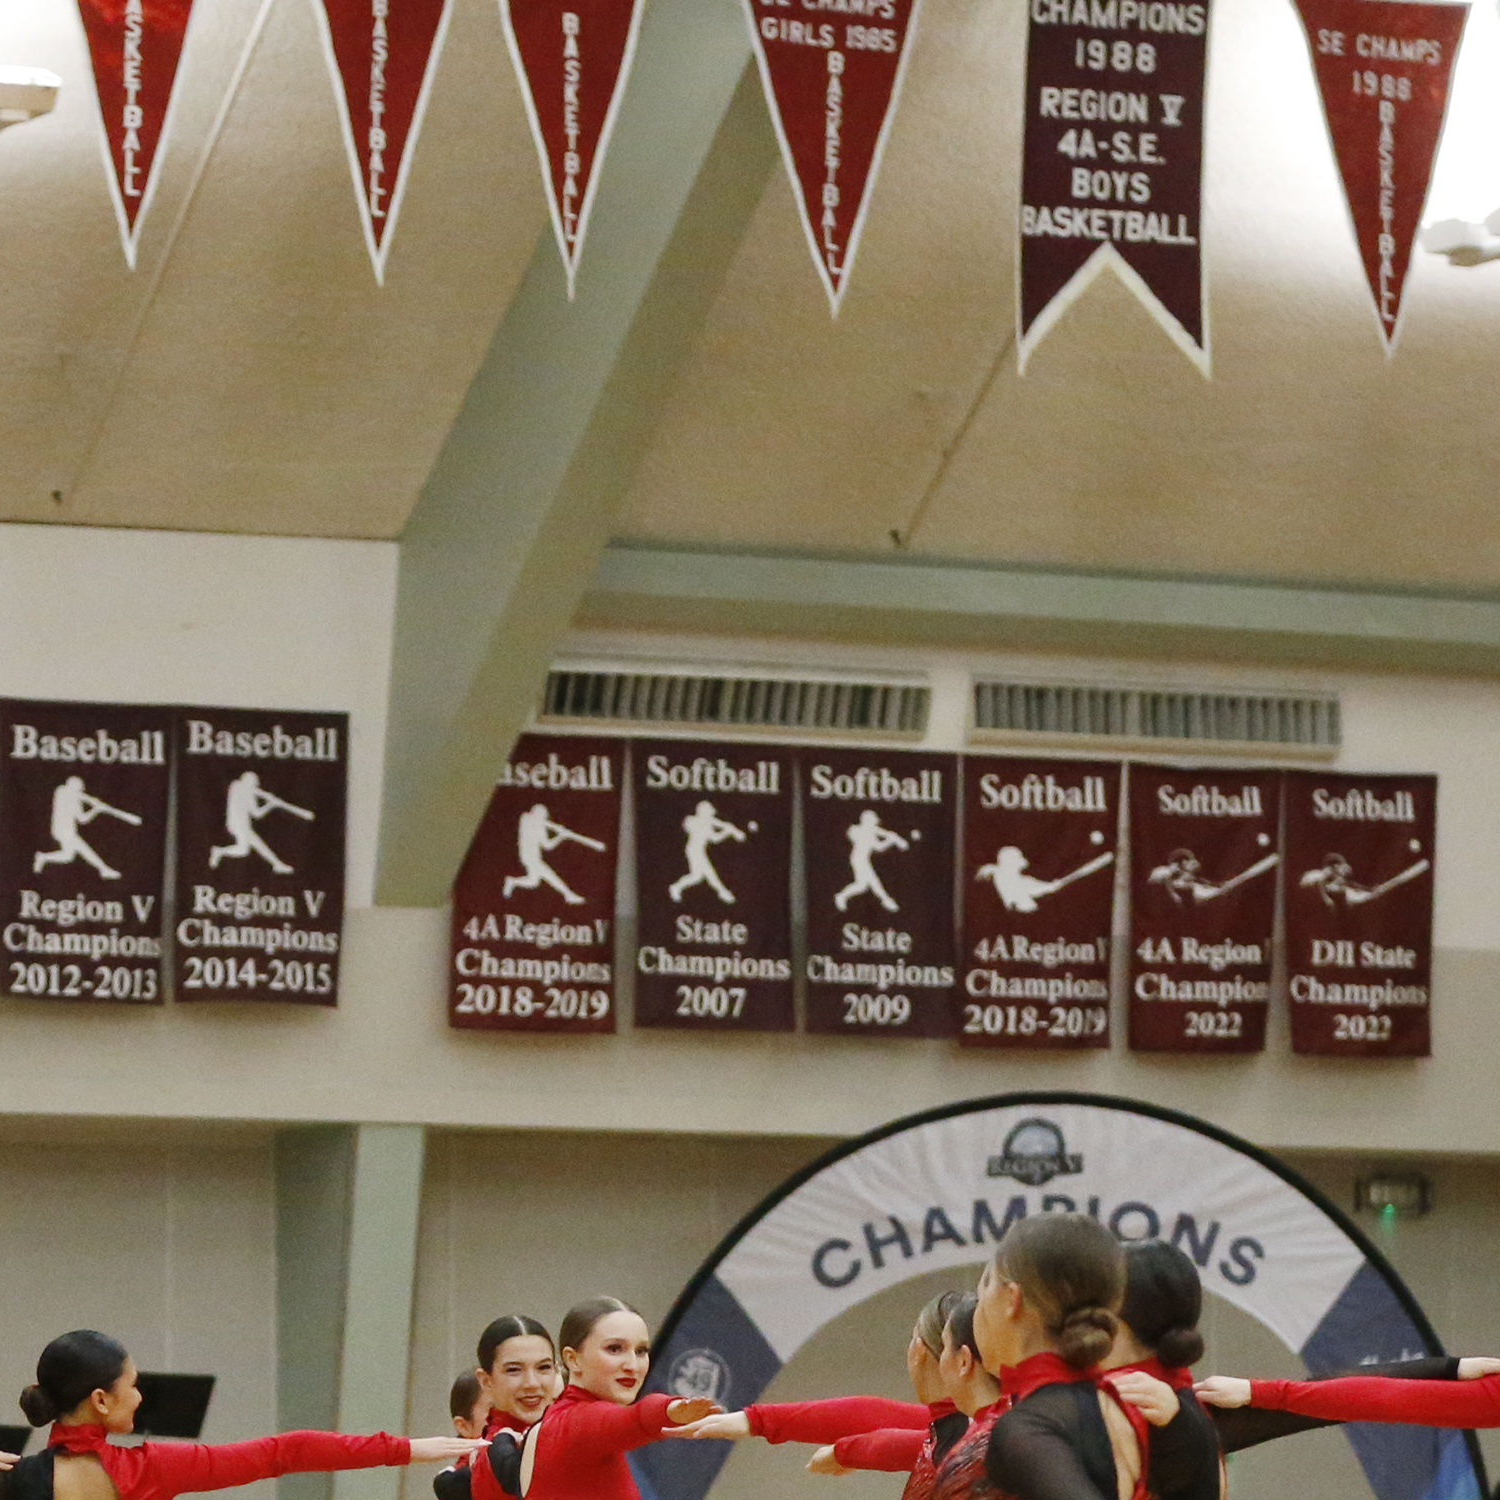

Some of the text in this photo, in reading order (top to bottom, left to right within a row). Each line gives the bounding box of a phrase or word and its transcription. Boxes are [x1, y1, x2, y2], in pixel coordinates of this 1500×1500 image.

[760, 17, 835, 49] GIRLS
[1317, 28, 1443, 66] SE CHAMPS
[1075, 38, 1157, 73] 1988
[1352, 70, 1412, 101] 1988
[1040, 86, 1186, 127] REGION V
[562, 12, 581, 242] BASKETBALL
[821, 50, 846, 275] BASKETBALL
[1057, 128, 1168, 165] 4A-S.E.
[1071, 167, 1151, 204] BOYS
[1021, 204, 1198, 246] BASKETBALL
[1378, 100, 1396, 322] BASKETBALL
[11, 725, 165, 765] Baseball
[187, 720, 338, 761] Baseball
[646, 755, 780, 794] Softball
[810, 765, 943, 803] Softball
[979, 773, 1108, 811] Softball
[1157, 785, 1263, 816] Softball
[1312, 788, 1415, 822] Softball
[20, 890, 154, 925] Region V
[194, 885, 326, 920] Region V
[3, 924, 161, 958] Champions
[177, 918, 338, 952] Champions
[463, 914, 599, 946] 4A Region
[676, 915, 748, 944] State
[842, 922, 911, 952] State
[456, 949, 611, 983] Champions
[637, 946, 791, 980] Champions
[974, 935, 1007, 960] 4A
[1009, 936, 1096, 968] Region
[1137, 938, 1175, 962] 4A
[1181, 936, 1263, 970] Region
[1359, 942, 1416, 969] State
[10, 962, 158, 999] 2012-2013
[184, 957, 332, 993] 2014-2015
[806, 954, 955, 988] Champions
[966, 968, 1108, 1003] Champions
[456, 984, 610, 1018] 2018-2019
[676, 986, 747, 1018] 2007
[842, 993, 910, 1024] 2009
[1290, 975, 1427, 1009] Champions
[1183, 1011, 1242, 1038] 2022
[1334, 1014, 1392, 1041] 2022
